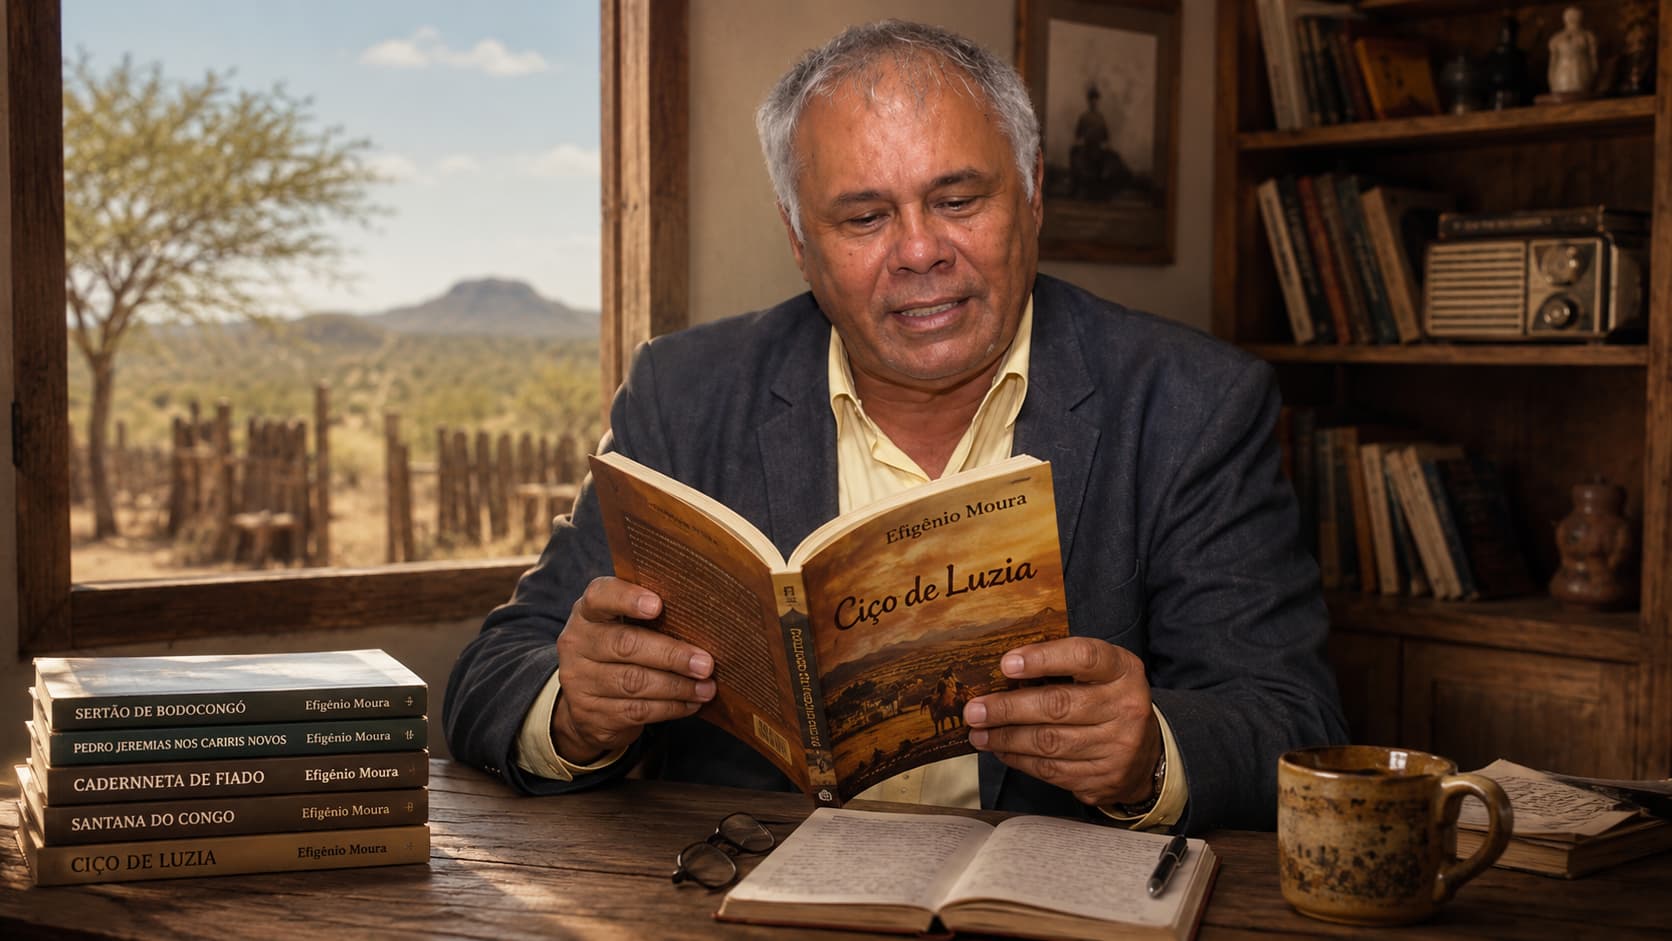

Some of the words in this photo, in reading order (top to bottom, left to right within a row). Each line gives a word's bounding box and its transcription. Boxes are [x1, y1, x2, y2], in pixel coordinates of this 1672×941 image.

[886, 511, 961, 545] Efigênio
[965, 494, 1028, 519] Moura
[834, 596, 898, 632] Ciço
[904, 575, 940, 608] de
[945, 557, 1038, 598] Luzia
[75, 704, 130, 720] SERTÃO
[134, 705, 153, 718] DE
[156, 700, 246, 717] BODOCONGÓ
[353, 698, 390, 709] Moura
[73, 742, 114, 754] PEDRO
[115, 739, 172, 753] JEREMIAS
[174, 738, 198, 749] NOS
[200, 736, 245, 749] CARIRIS
[247, 734, 288, 746] NOVOS
[355, 731, 391, 742] Moura
[73, 774, 185, 792] CADERNNETA
[189, 773, 211, 787] DE
[215, 770, 265, 786] FIADO
[359, 766, 399, 779] Moura
[71, 815, 147, 832] SANTANA
[150, 812, 175, 828] DO
[178, 809, 236, 826] CONGO
[352, 805, 390, 816] Moura
[350, 844, 387, 856] Moura
[71, 855, 120, 876] CIÇO
[127, 855, 153, 871] DE
[159, 850, 217, 868] LUZIA
